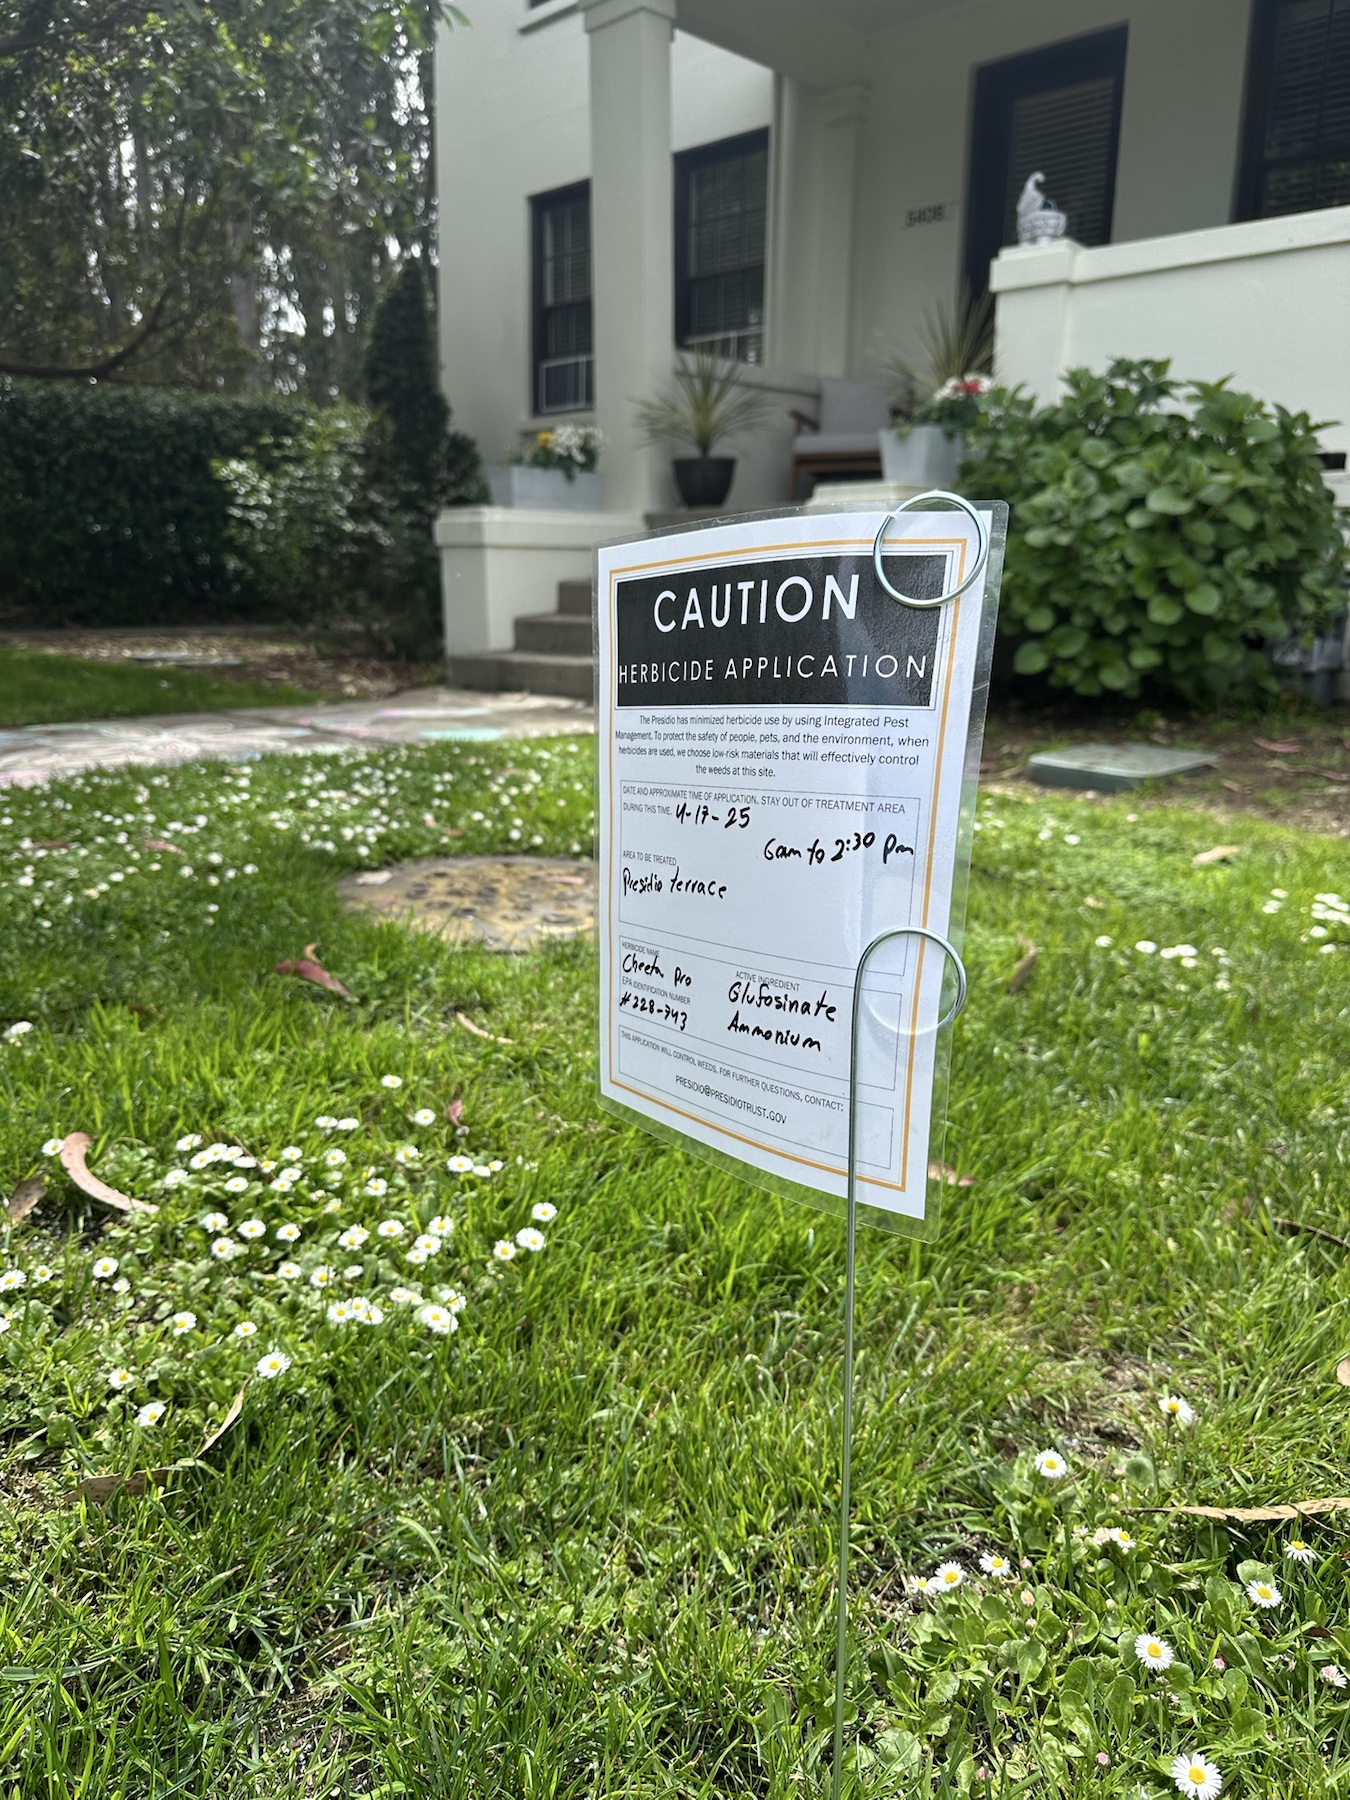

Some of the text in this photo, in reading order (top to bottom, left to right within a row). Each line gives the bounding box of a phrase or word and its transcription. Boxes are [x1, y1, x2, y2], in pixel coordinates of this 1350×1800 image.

[653, 574, 860, 633] CAUTION
[618, 654, 927, 684] HERBICIDE APPLICATION
[640, 715, 909, 728] The Presidio has minimized herbicide use by using Integrated Pest
[615, 730, 929, 747] Management. To protect the safety of people, pets, and the environment, when
[618, 745, 919, 765] herbicides are used, we choose low-risk materials that will effectively control
[695, 764, 776, 778] the weeds at this site.
[622, 786, 906, 814] DATE AND APPROXIMATE TIME OF APPLICATION. STAY OUT OF TREATMENT AREA
[623, 802, 673, 816] DURING THIS TIME.
[622, 850, 677, 866] AREA TO BE TREATED
[764, 837, 801, 861] 6am
[807, 838, 825, 866] to
[830, 831, 876, 862] 2:30
[622, 866, 727, 899] Presidio terrace
[621, 941, 660, 957] HERBICIDE NAME
[621, 976, 691, 1005] EPA IDENTIFICATION NUMBER
[735, 971, 800, 992] ACTIVE INGREDIENT
[621, 1030, 844, 1112] THIS APPLICATION WILL CONTROL WEEDS. FOR FURTHER QUESTIONS, CONTACT:
[675, 1075, 787, 1124] PRESIDIO@PRESIDIOTRUST.GOV
